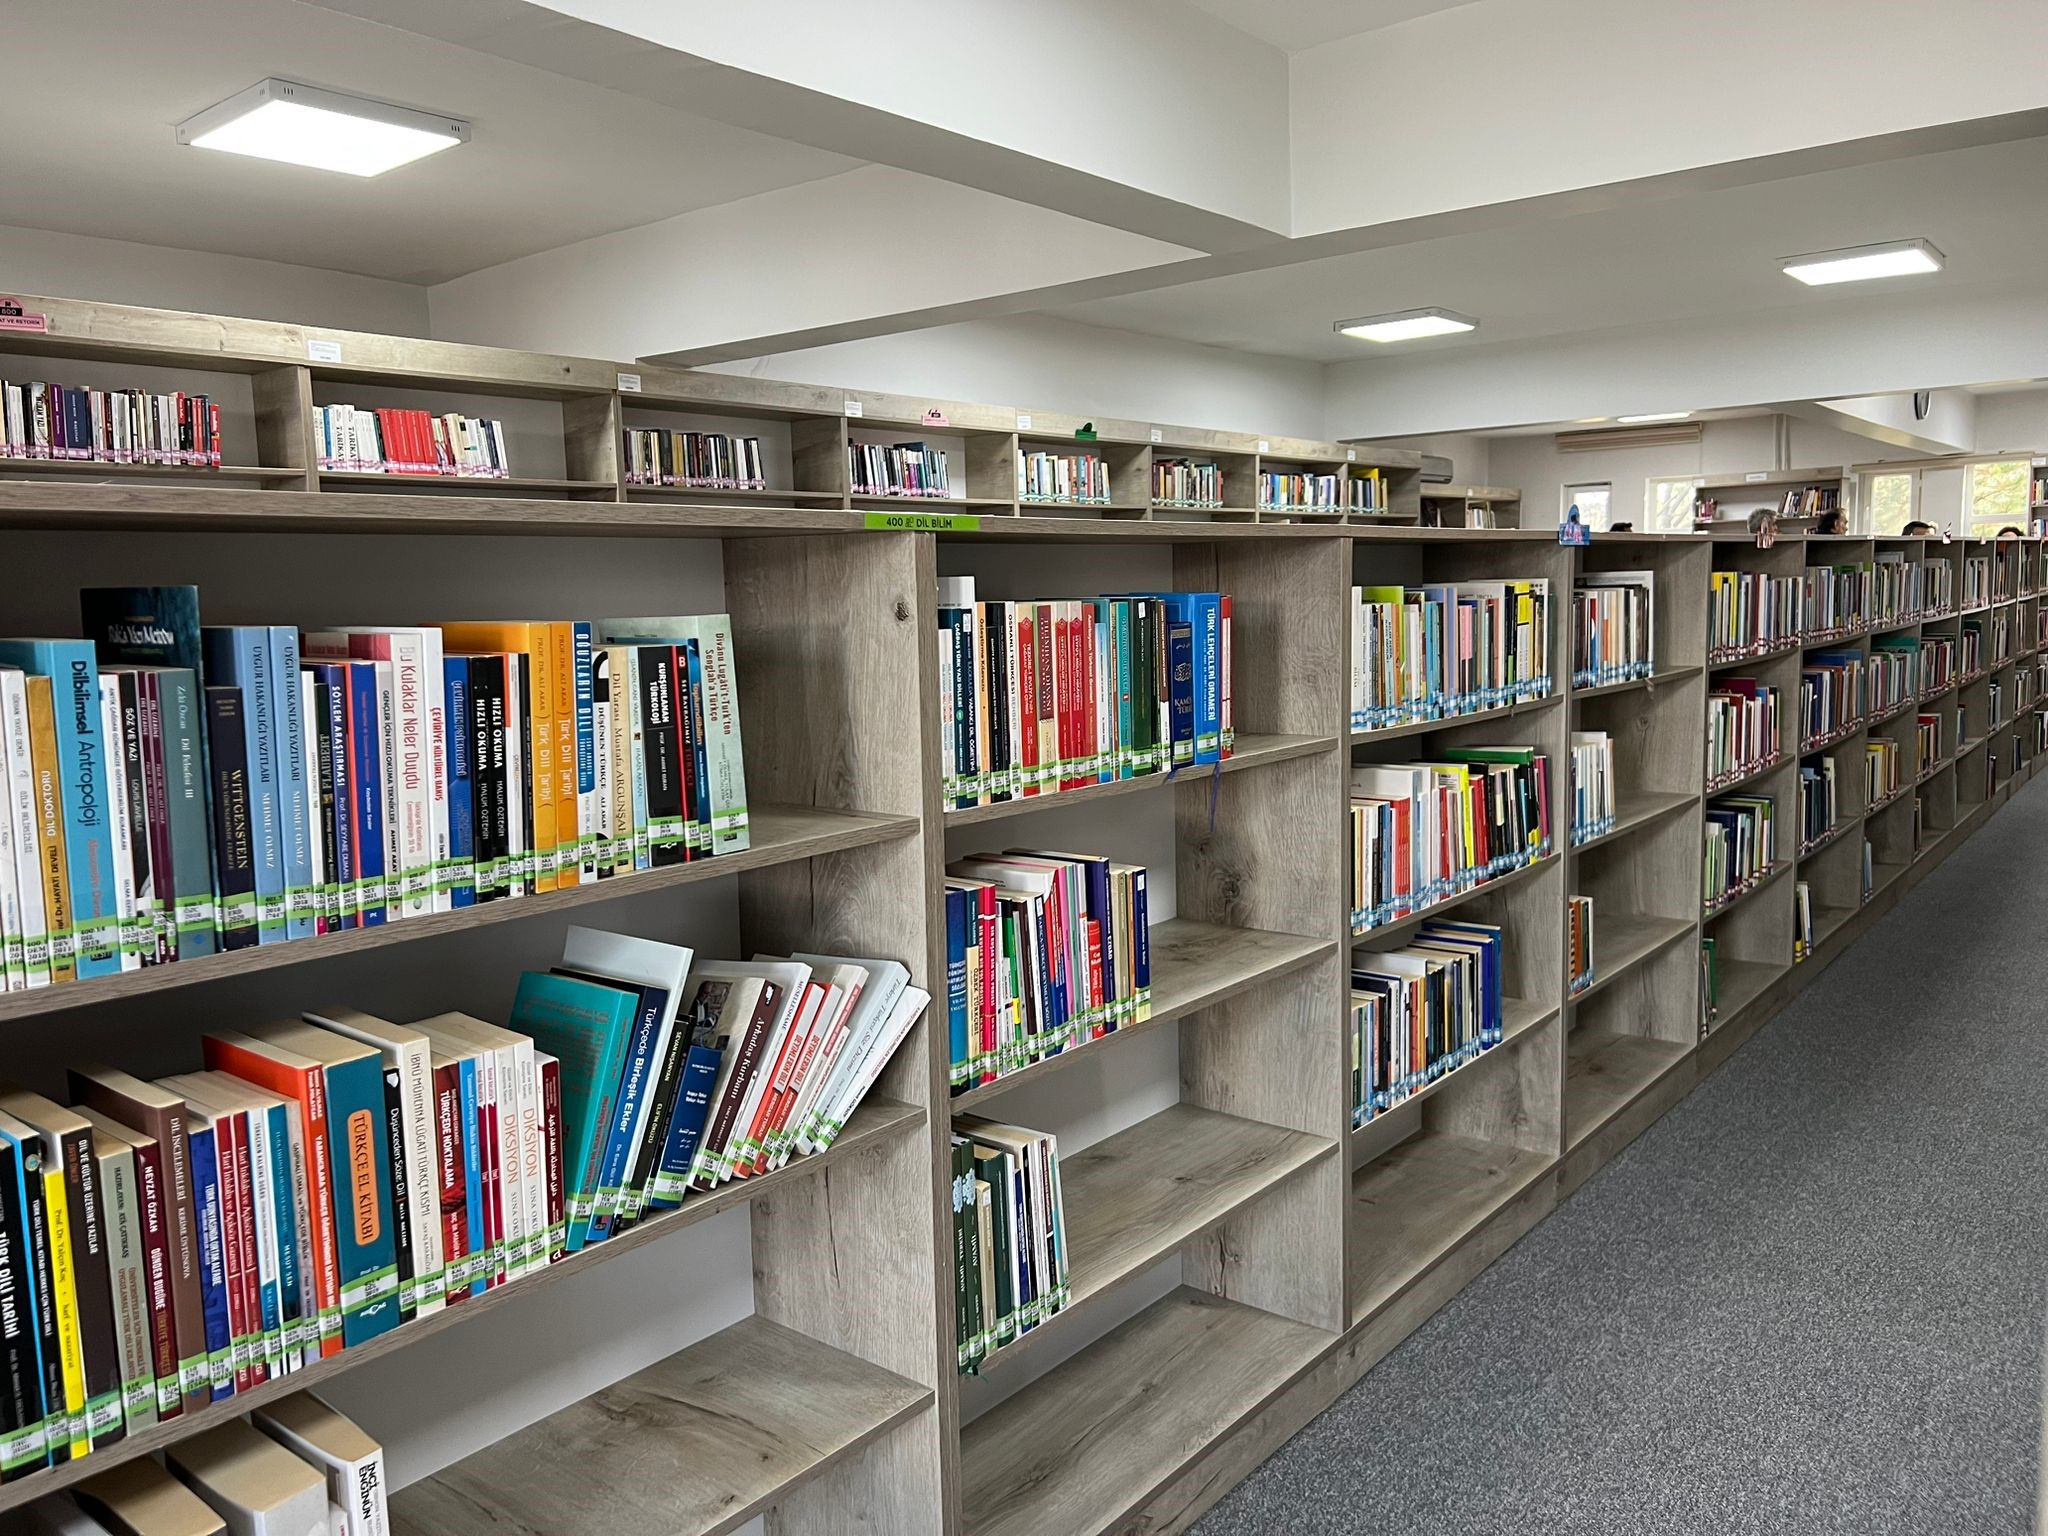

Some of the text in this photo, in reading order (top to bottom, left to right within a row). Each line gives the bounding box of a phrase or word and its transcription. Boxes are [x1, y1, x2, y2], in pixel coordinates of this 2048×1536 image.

[886, 517, 952, 528] 400 DİL BİLİM
[252, 646, 264, 679] UYGUR
[284, 646, 294, 679] UYGUR
[612, 673, 620, 688] Dil
[1206, 607, 1216, 721] TÜRK LEHÇELERİ GRAMERİ
[72, 660, 94, 734] Dilbilimsel
[400, 664, 417, 713] Kulaklar
[576, 634, 593, 732] OĞUZLARIN DİLİ
[658, 662, 670, 723] KURŞUNLANAN
[126, 708, 135, 725] SÖZ
[255, 681, 268, 734] HAKANLIĞI
[286, 681, 300, 733] HAKANLIĞI
[476, 699, 486, 727] HIZLI
[492, 698, 502, 726] HIZLI
[614, 690, 622, 721] Yarası
[650, 682, 662, 724] TÜRKOLOJİ
[128, 726, 137, 740] VE
[332, 686, 346, 786] SÖYLEM ARAŞTIRMASI
[404, 718, 418, 748] Neler
[430, 706, 444, 744] ÇEVİRİYE
[536, 722, 550, 745] Türk
[558, 718, 571, 741] Türk
[598, 707, 606, 750] DÜŞÜNEN
[258, 734, 270, 783] YAZITLARI
[289, 734, 300, 781] YAZITLARI
[320, 734, 332, 790] FLAUBERT
[478, 731, 488, 770] OKUMA
[493, 729, 503, 768] OKUMA
[614, 728, 623, 766] Mustafa
[75, 740, 100, 826] Antropoloji
[402, 752, 420, 790] Duydu
[434, 780, 444, 801] BAKIŞ
[600, 752, 608, 790] TÜRKÇE
[41, 770, 56, 818] DOKTORU
[231, 769, 249, 869] WITTGENSTEIN
[885, 978, 902, 1003] Türkiye
[674, 1032, 682, 1050] SEVAN
[730, 1016, 764, 1099] Arkadaş Kurbanı
[620, 1007, 658, 1134] Türkçede Birleşik Ekler
[170, 1117, 180, 1134] DİL
[440, 1090, 454, 1189] TÜRKÇEDE NOKTALAMA
[523, 1108, 538, 1178] DİKSİYON
[172, 1134, 186, 1201] İNCELEMELERİ
[390, 1107, 405, 1196] Düşünceden Dil
[504, 1113, 519, 1184] DİKSİYON
[144, 1166, 154, 1200] NEVZAT
[353, 1114, 374, 1240] TÜRKÇE EL KİTABI
[417, 1155, 429, 1190] TÜRKÇE
[146, 1202, 158, 1233] ÖZKAN
[420, 1190, 431, 1217] KISMI
[2, 1294, 20, 1340] TARİHİ
[358, 1465, 374, 1520] ENGİNÜN
[366, 1460, 380, 1492] İNCİ
